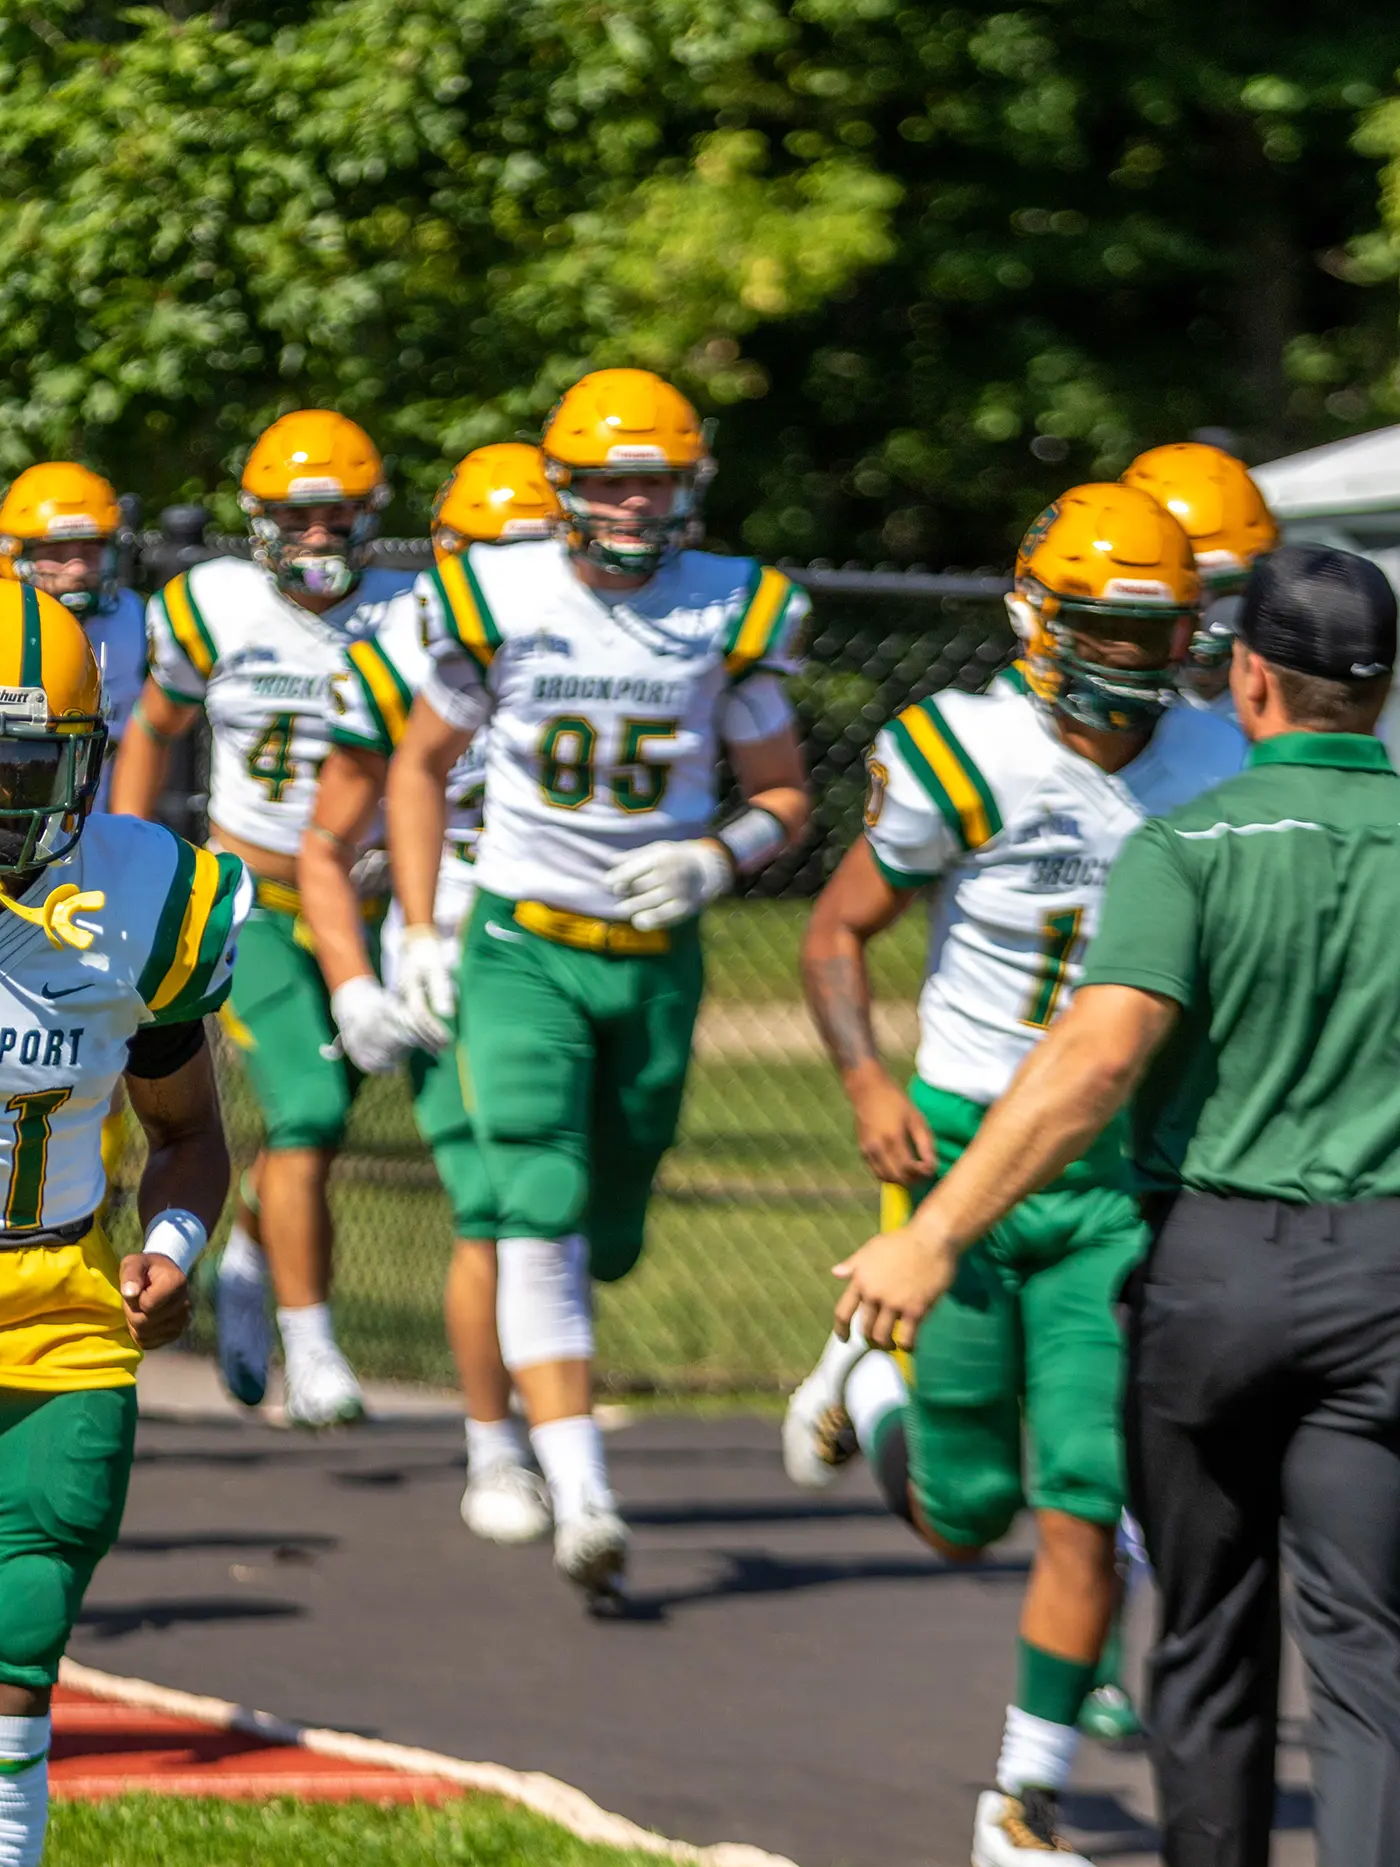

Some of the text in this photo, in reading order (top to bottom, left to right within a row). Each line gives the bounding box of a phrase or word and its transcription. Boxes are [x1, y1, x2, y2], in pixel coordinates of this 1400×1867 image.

[533, 675, 679, 704] BROCKPORT
[248, 712, 297, 803] 4
[538, 715, 680, 814] 85
